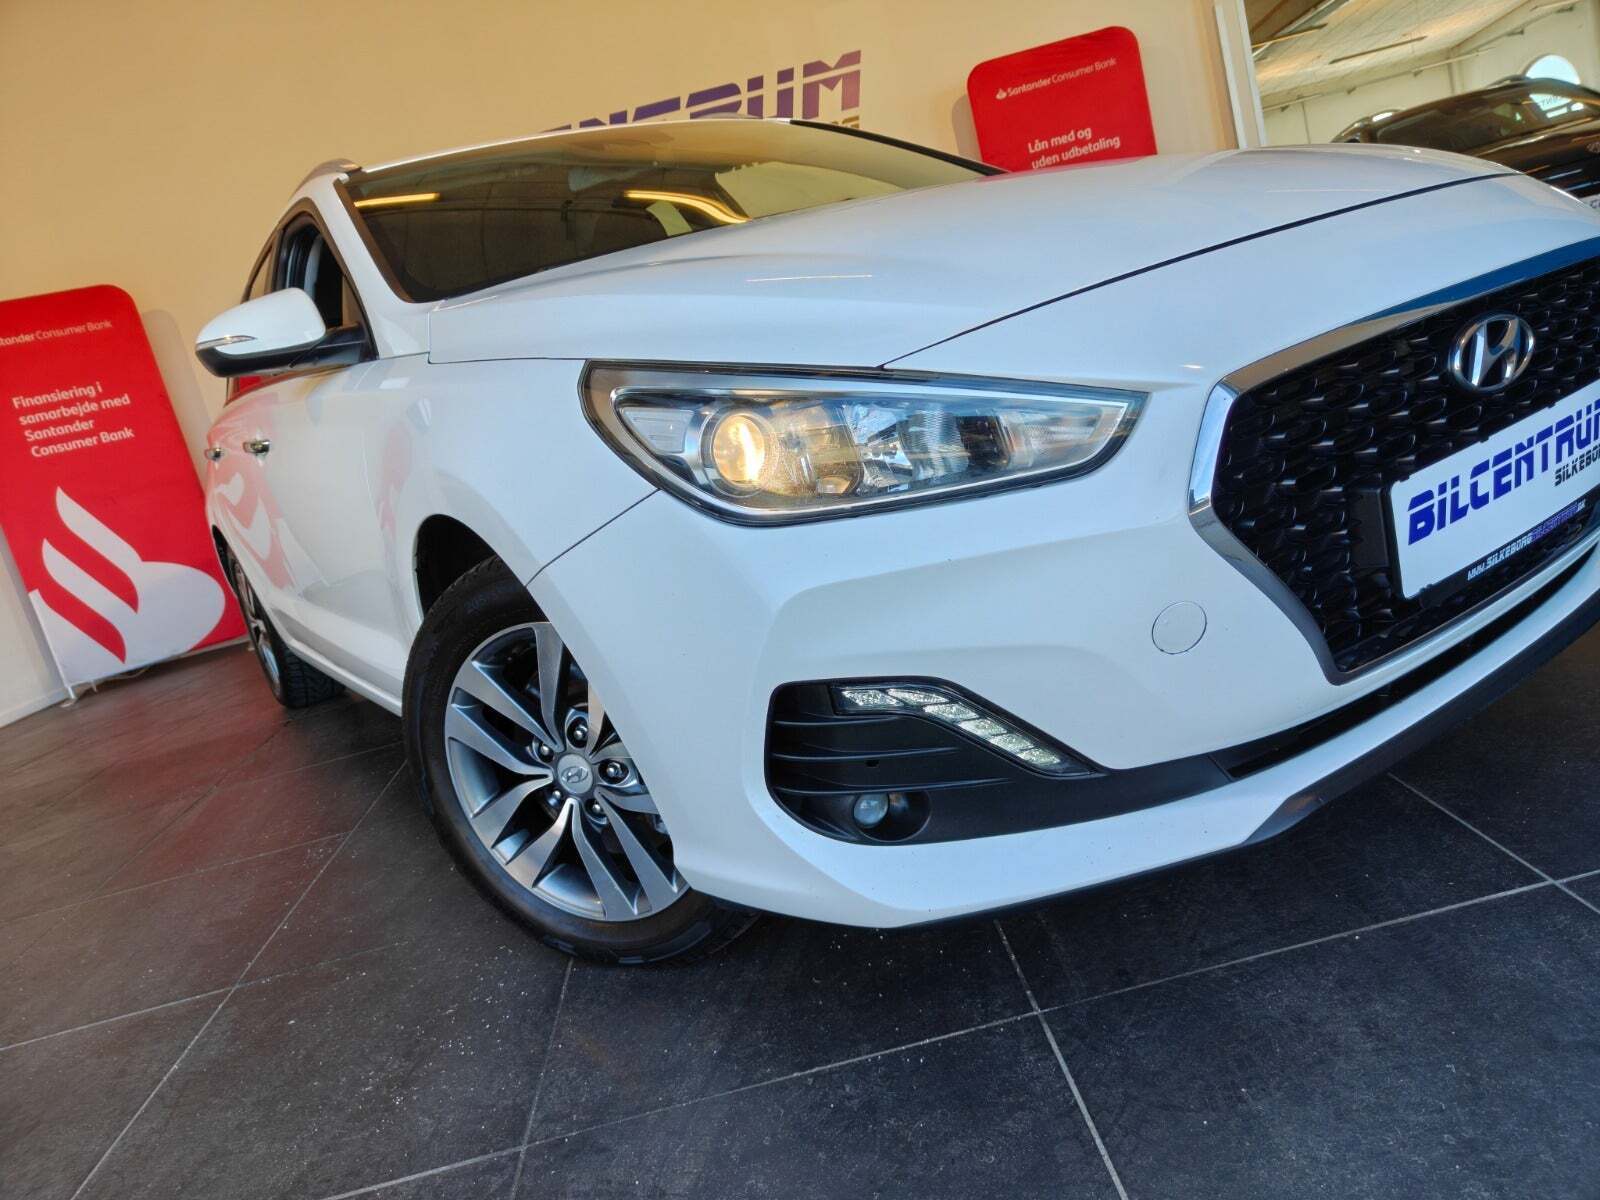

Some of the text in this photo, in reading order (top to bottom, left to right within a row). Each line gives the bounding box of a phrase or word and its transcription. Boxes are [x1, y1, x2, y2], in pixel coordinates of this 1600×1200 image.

[1007, 57, 1117, 97] Santander Consumer Bank
[1028, 127, 1092, 154] Lån med og
[1032, 136, 1121, 170] uden udbetaling
[35, 325, 87, 341] Consumer
[87, 319, 112, 332] Bank
[12, 384, 95, 409] Finansiering
[19, 394, 131, 426] samarbejde med
[24, 419, 95, 442] Santander
[31, 427, 135, 458] Consumer Bank
